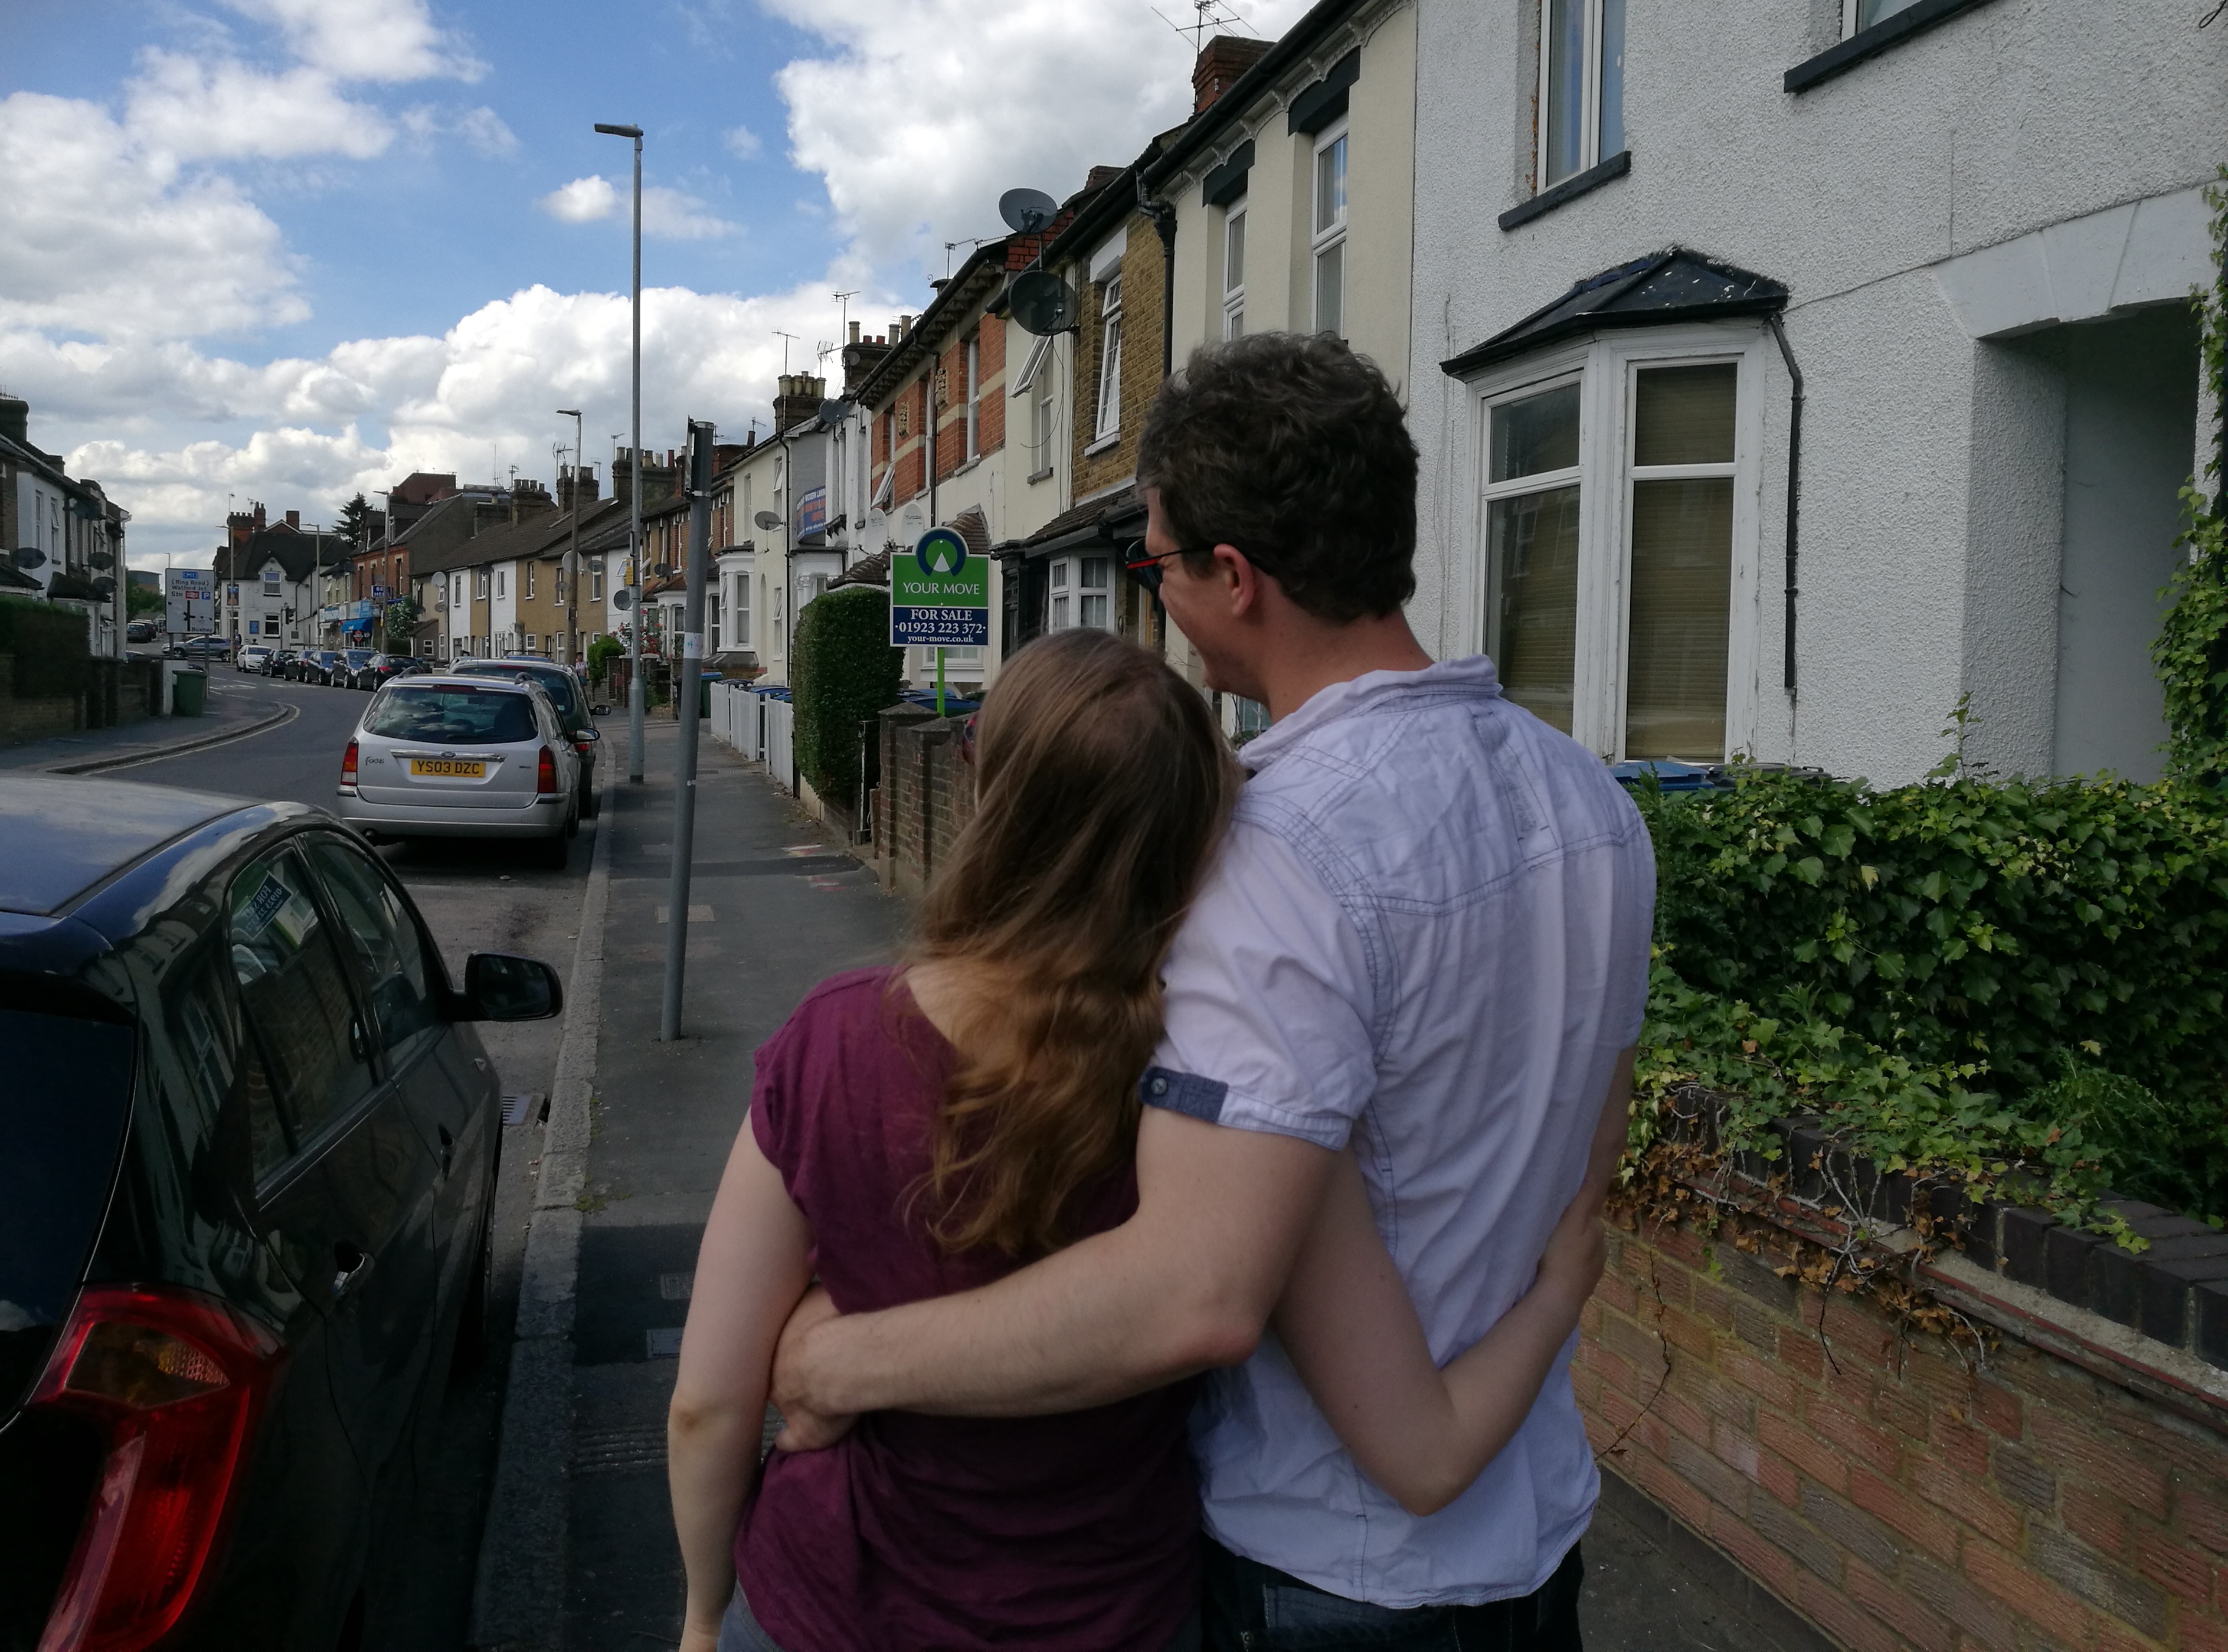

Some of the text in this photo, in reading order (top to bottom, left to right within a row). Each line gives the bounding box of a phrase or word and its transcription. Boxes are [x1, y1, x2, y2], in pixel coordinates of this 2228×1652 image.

[903, 582, 980, 595] YOUR MOVE
[910, 609, 973, 621] FOR SALE
[899, 622, 983, 634] 01923 223 372
[907, 634, 974, 643] your-move.co.uk
[417, 760, 480, 774] YS03 DZC
